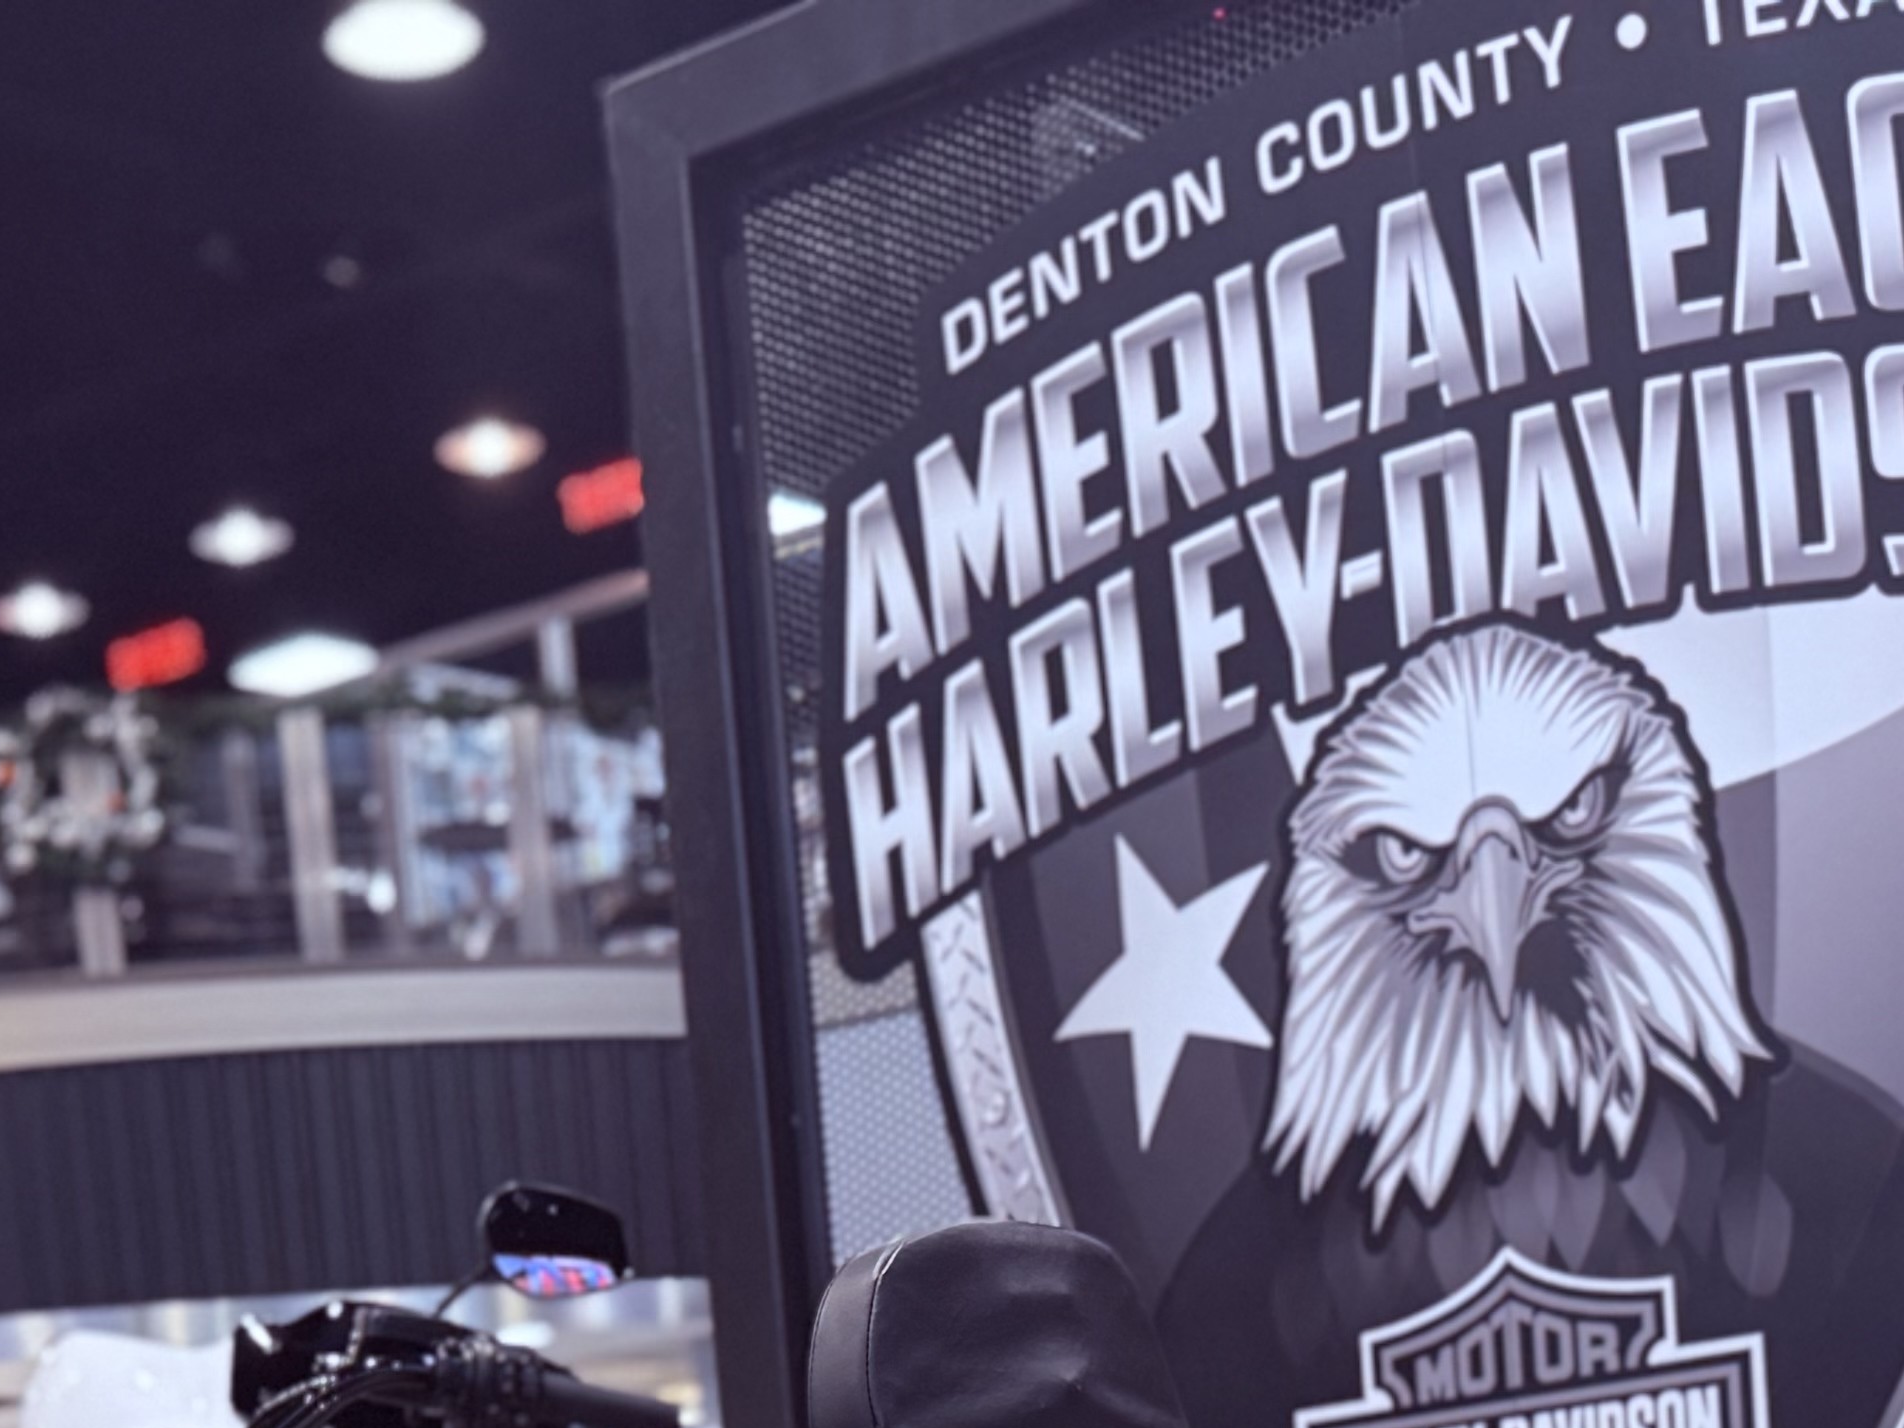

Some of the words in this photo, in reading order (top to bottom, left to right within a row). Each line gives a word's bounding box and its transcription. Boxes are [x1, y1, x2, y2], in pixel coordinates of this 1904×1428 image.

[940, 155, 1227, 376] DENTON
[1254, 13, 1574, 195] COUNTY
[844, 142, 1591, 722] AMERICAN
[1413, 1300, 1623, 1410] MOTOR
